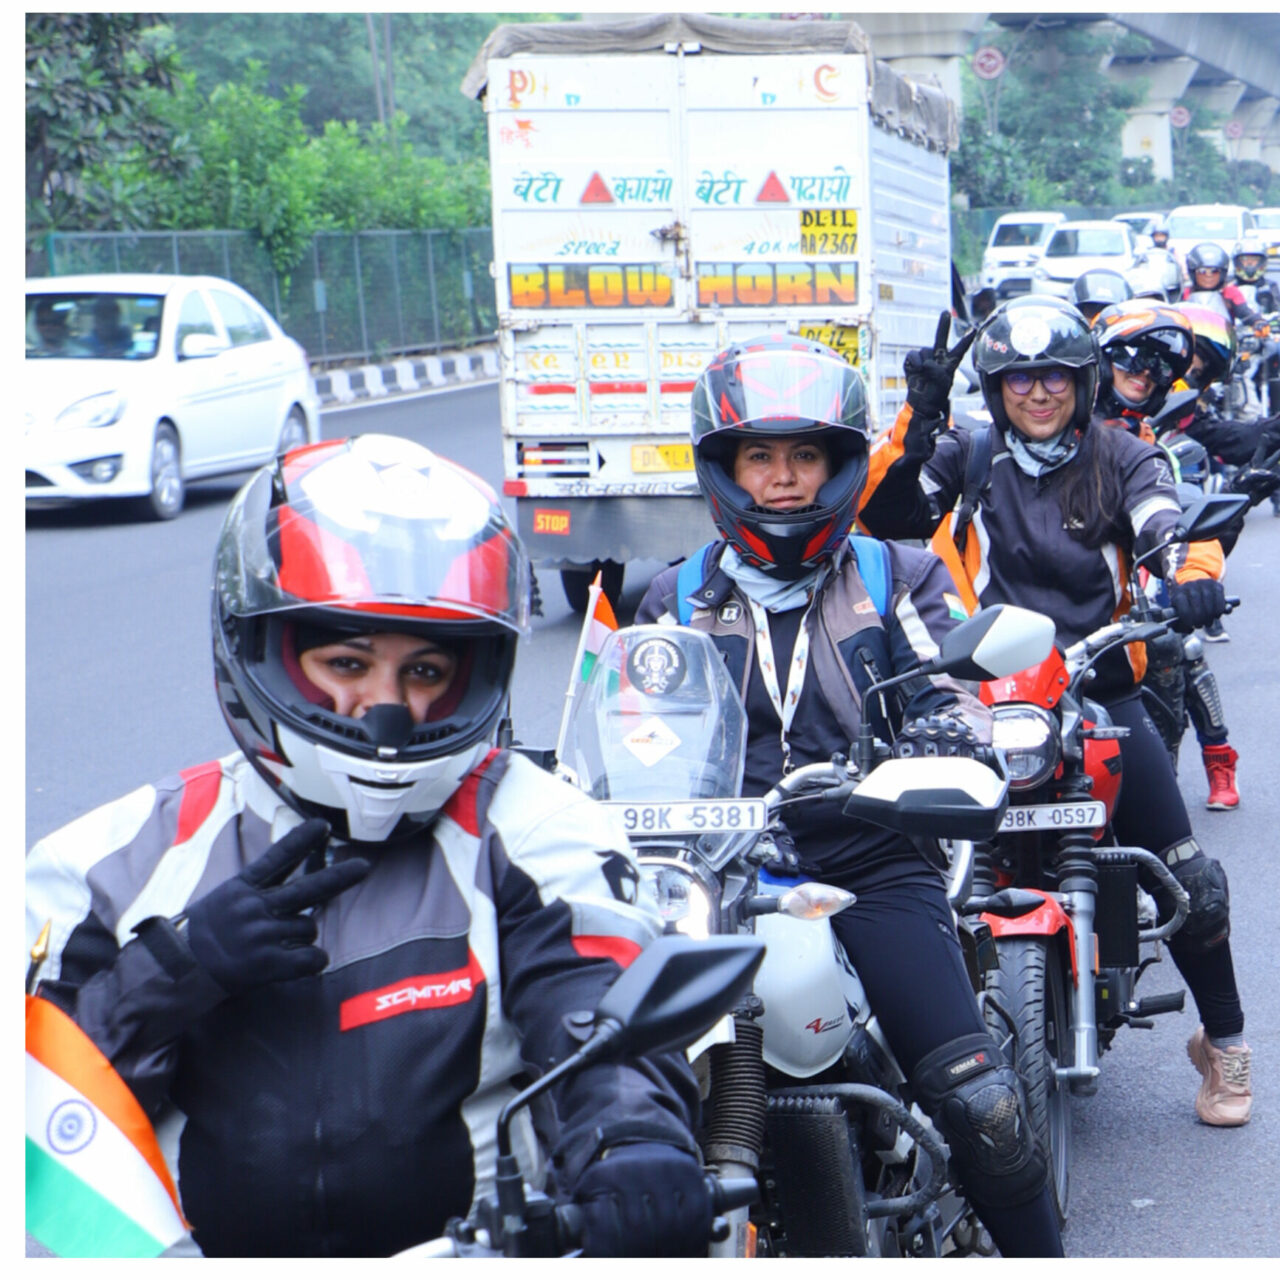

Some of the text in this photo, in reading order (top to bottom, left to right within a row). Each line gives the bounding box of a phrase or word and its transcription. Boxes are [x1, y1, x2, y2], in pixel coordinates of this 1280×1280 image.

[510, 263, 857, 308] BLOW HORN
[536, 514, 569, 531] STOP
[623, 805, 757, 831] 98K 5381
[1004, 807, 1097, 828] 98K 0597
